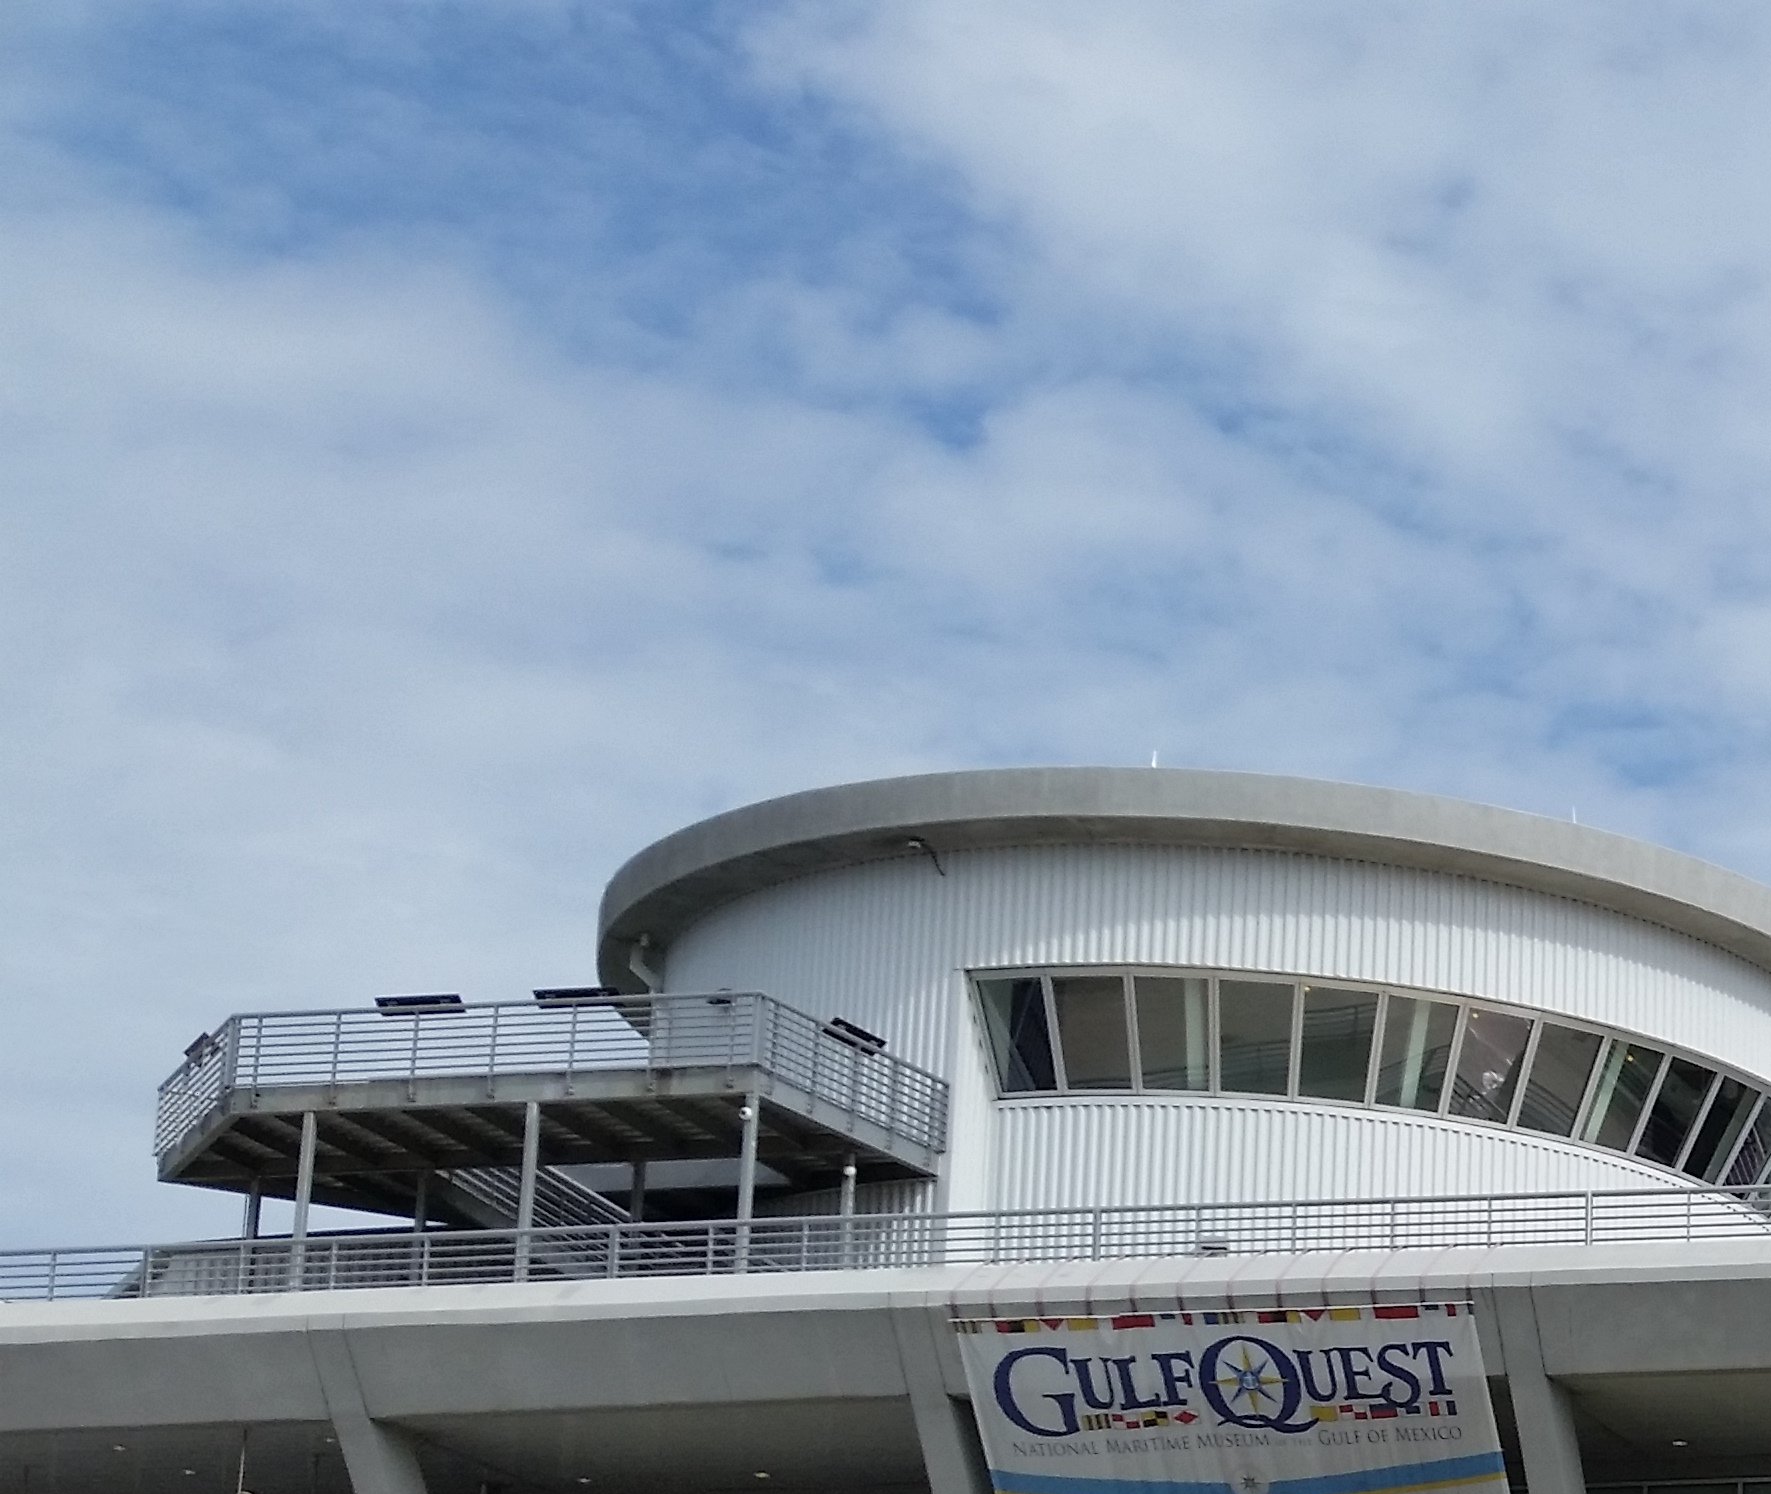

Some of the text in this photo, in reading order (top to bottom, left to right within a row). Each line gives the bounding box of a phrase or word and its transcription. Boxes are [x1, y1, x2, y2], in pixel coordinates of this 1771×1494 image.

[993, 1335, 1454, 1437] GULFQUEST
[1012, 1440, 1099, 1458] NATIONAL
[1106, 1435, 1190, 1454] MARITIME
[1196, 1432, 1271, 1449] MUSEUM
[1317, 1428, 1361, 1447] GULF
[1367, 1427, 1389, 1444] OF
[1398, 1424, 1464, 1443] MEXICO
